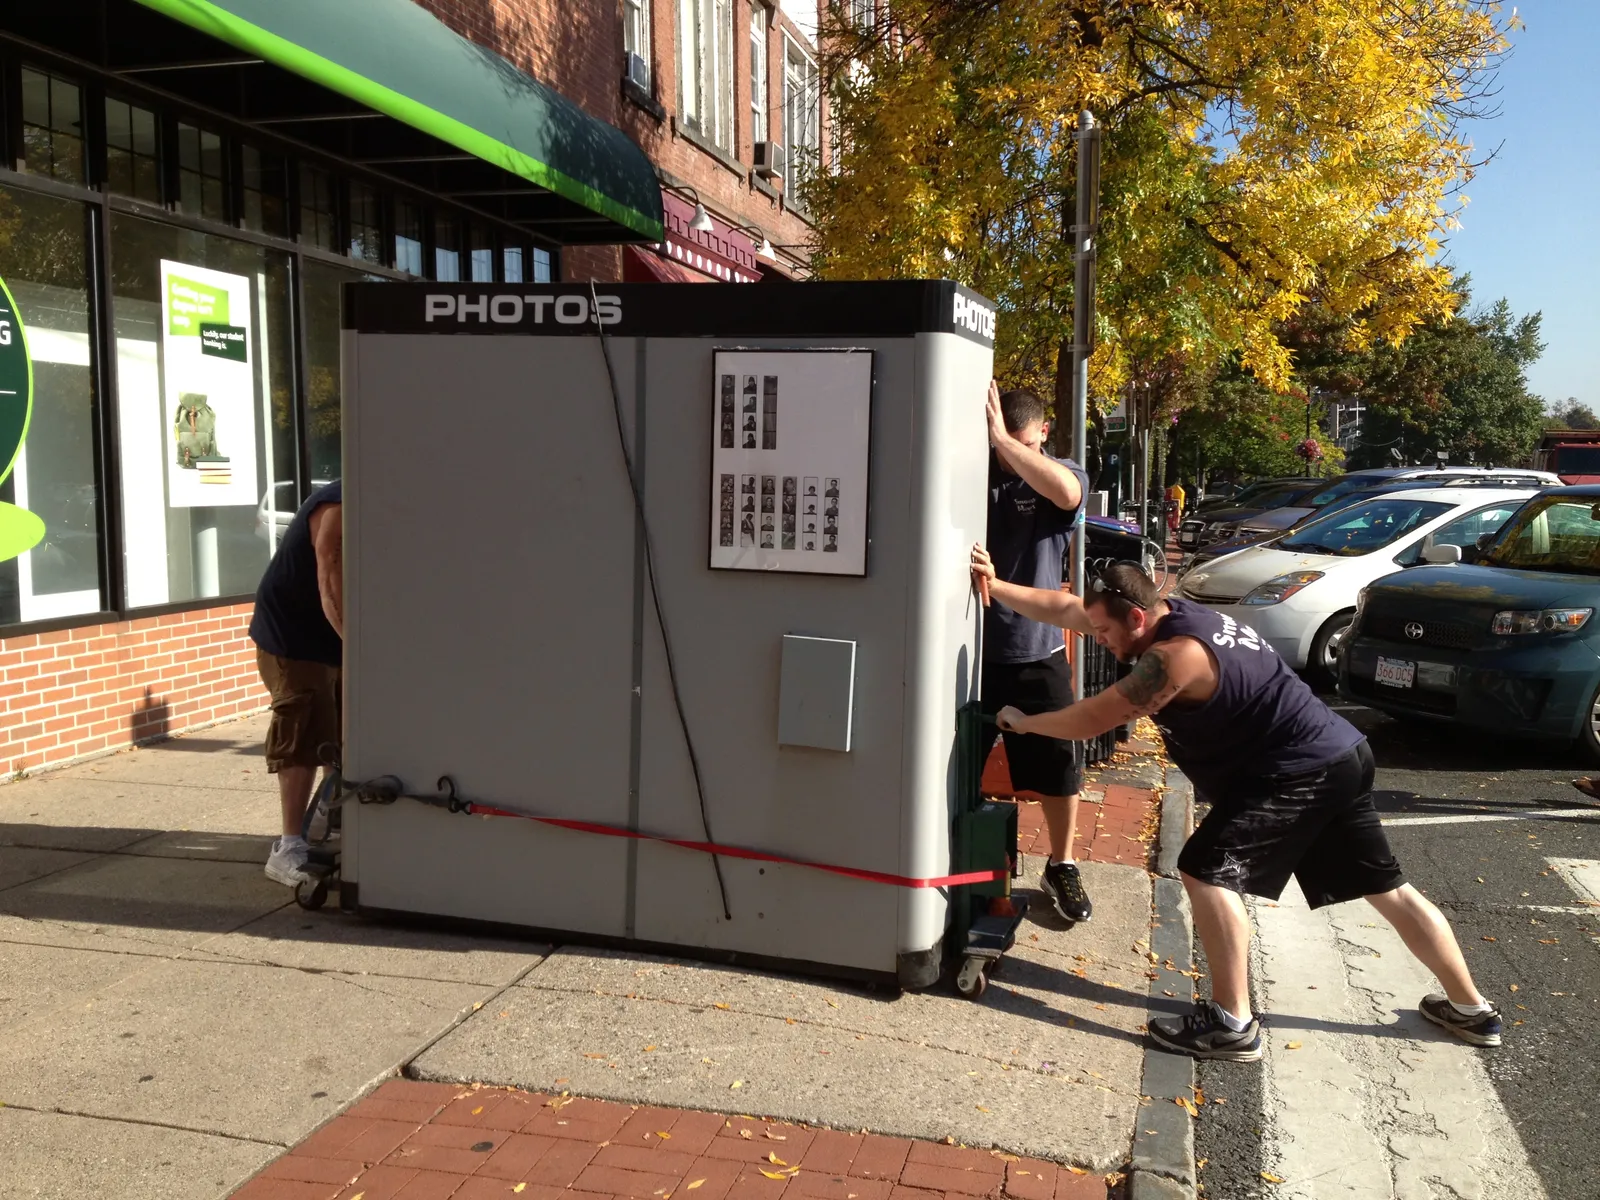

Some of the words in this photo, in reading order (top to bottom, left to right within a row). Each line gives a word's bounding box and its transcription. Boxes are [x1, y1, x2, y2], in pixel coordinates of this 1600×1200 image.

[425, 294, 622, 325] PHOTOS
[953, 292, 996, 340] PHOTOS
[227, 332, 244, 342] student
[1110, 454, 1119, 465] P
[1377, 663, 1394, 679] 366
